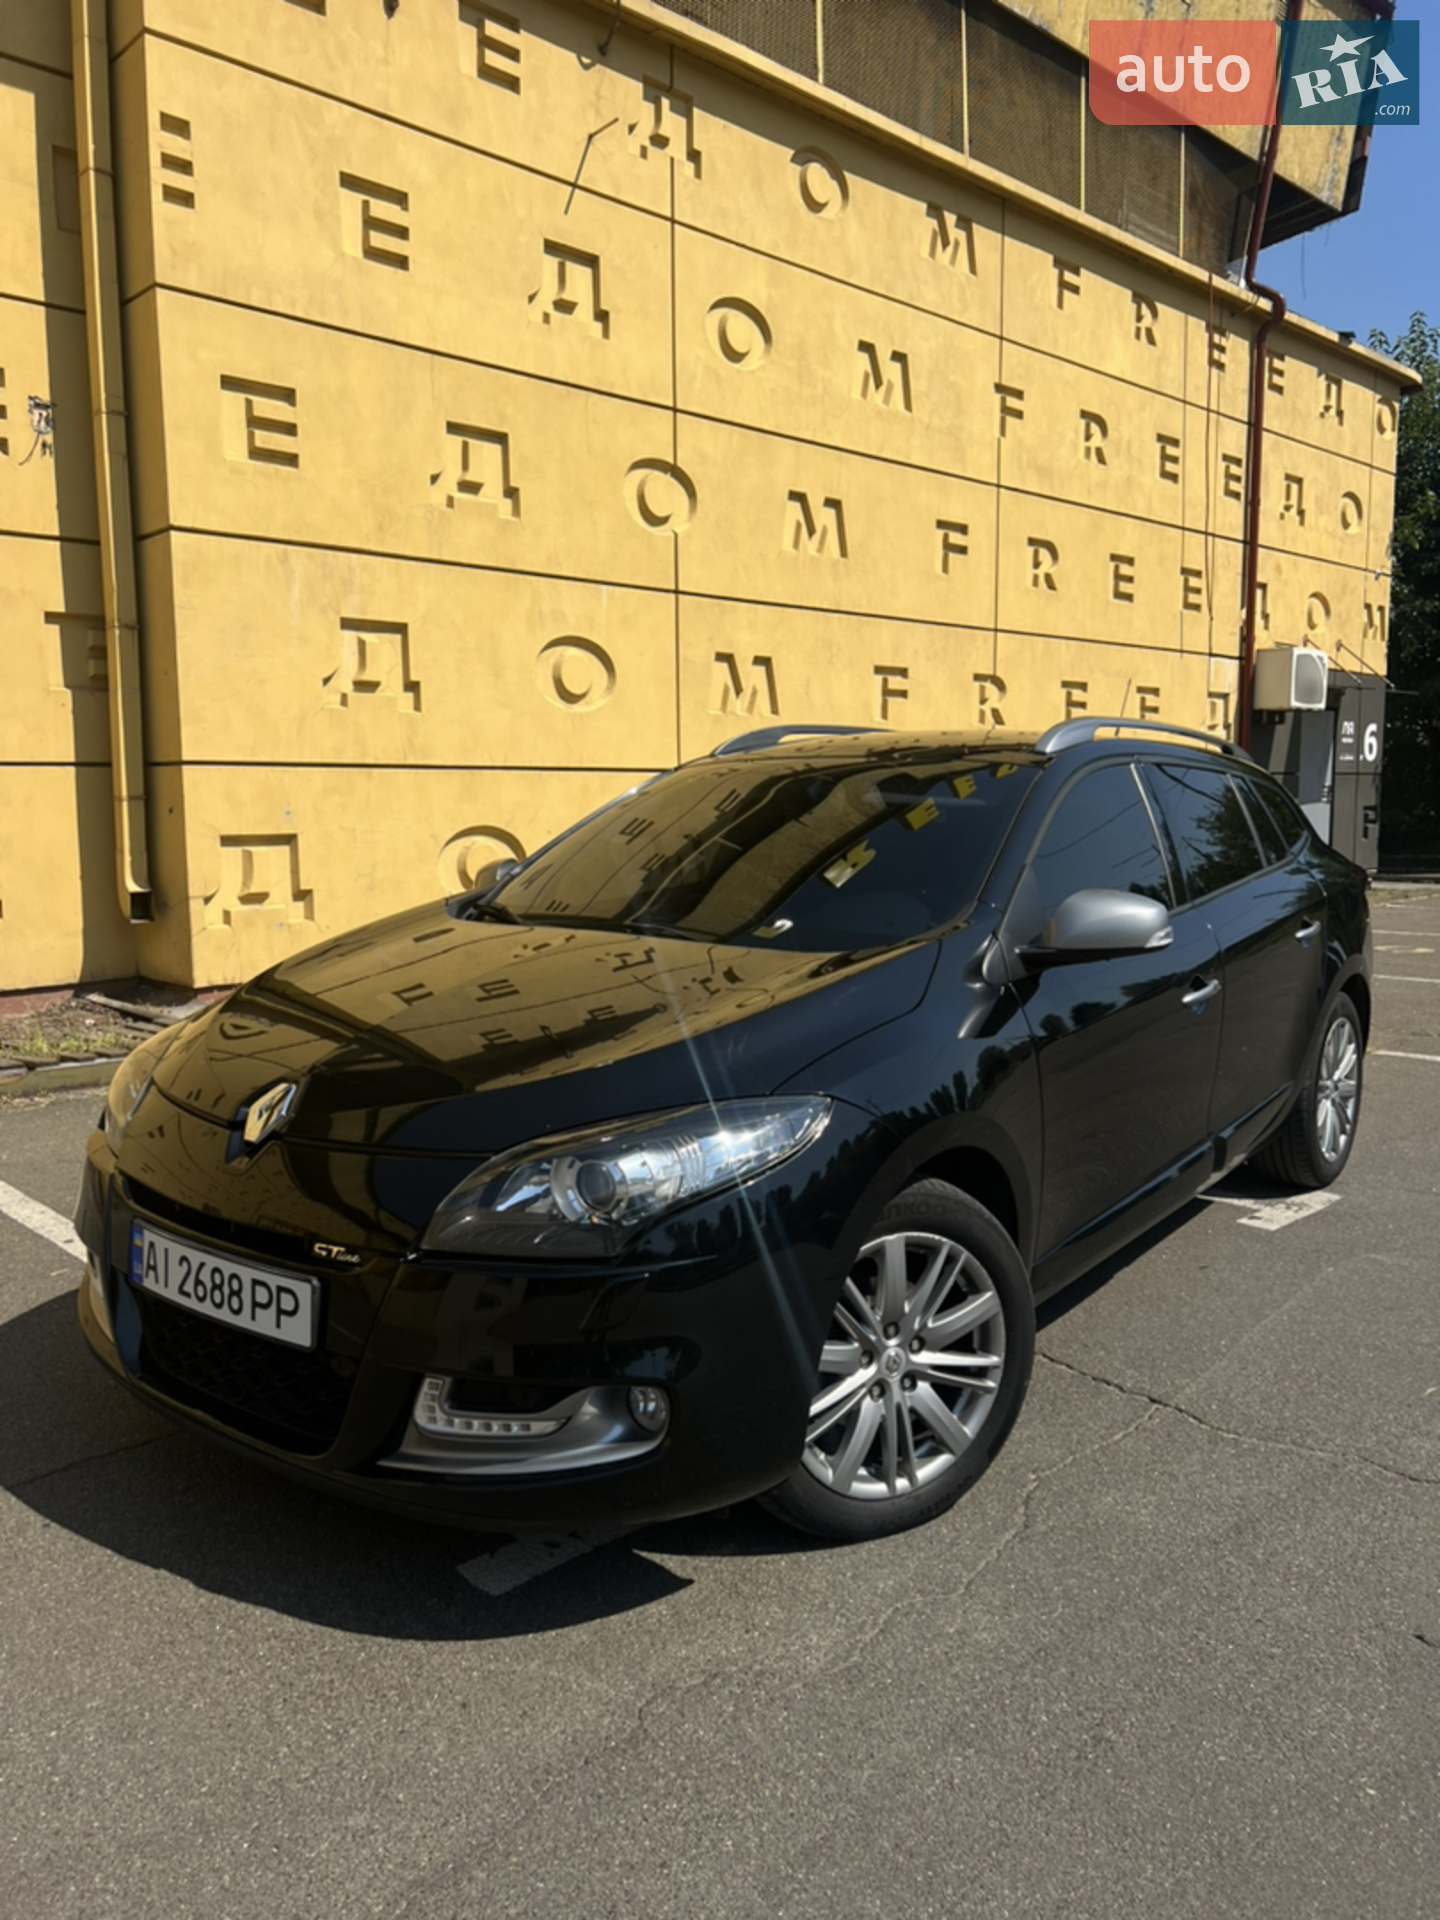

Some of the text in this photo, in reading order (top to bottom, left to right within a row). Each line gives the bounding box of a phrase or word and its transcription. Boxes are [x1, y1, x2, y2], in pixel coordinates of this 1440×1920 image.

[144, 1240, 300, 1330] AI 2688 PP
